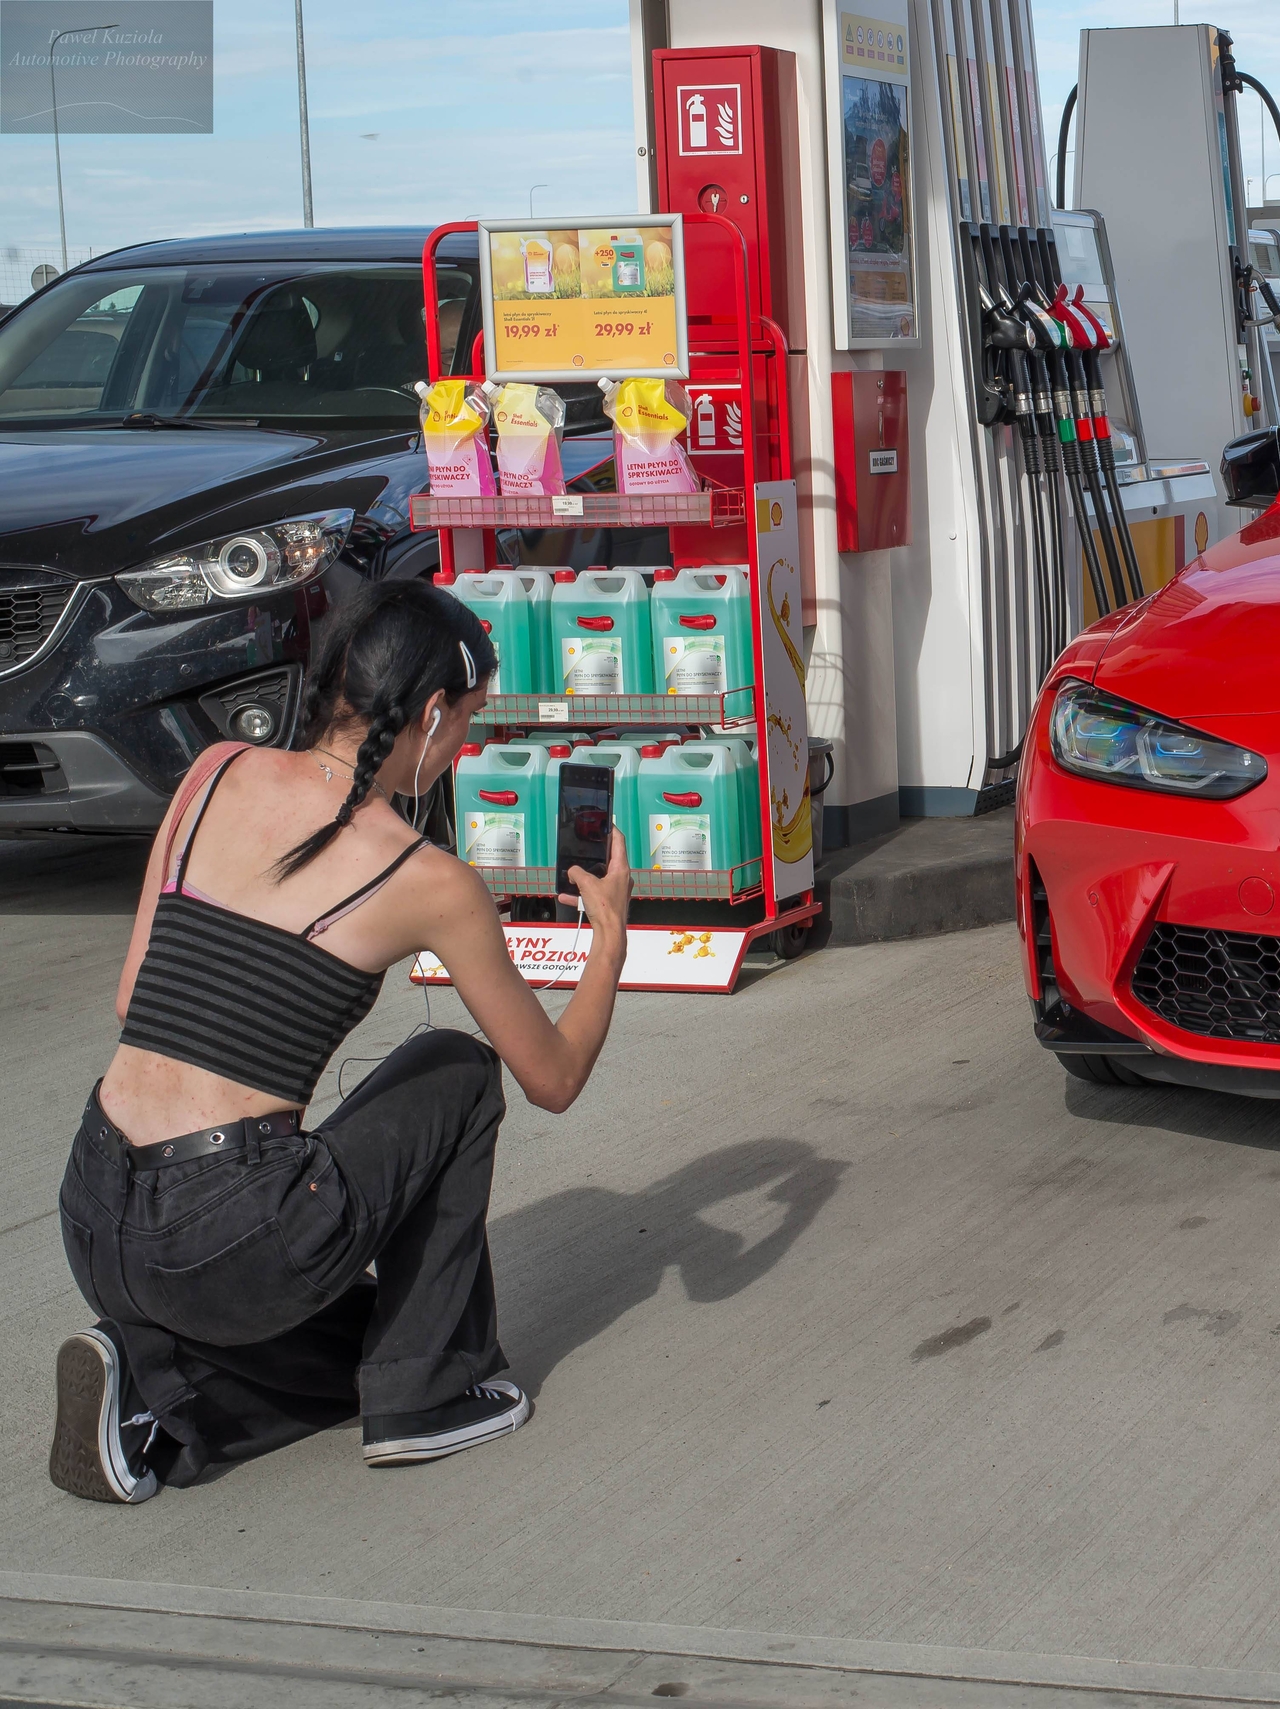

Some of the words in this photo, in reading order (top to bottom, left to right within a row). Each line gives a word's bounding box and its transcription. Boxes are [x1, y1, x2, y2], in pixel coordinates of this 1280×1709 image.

[504, 324, 540, 339] 19,99
[594, 322, 634, 338] 29,99
[638, 410, 668, 420] Essentials
[511, 418, 538, 427] Essentials
[628, 467, 682, 478] SPRYSKIWACZY
[506, 937, 552, 948] ŁYNY
